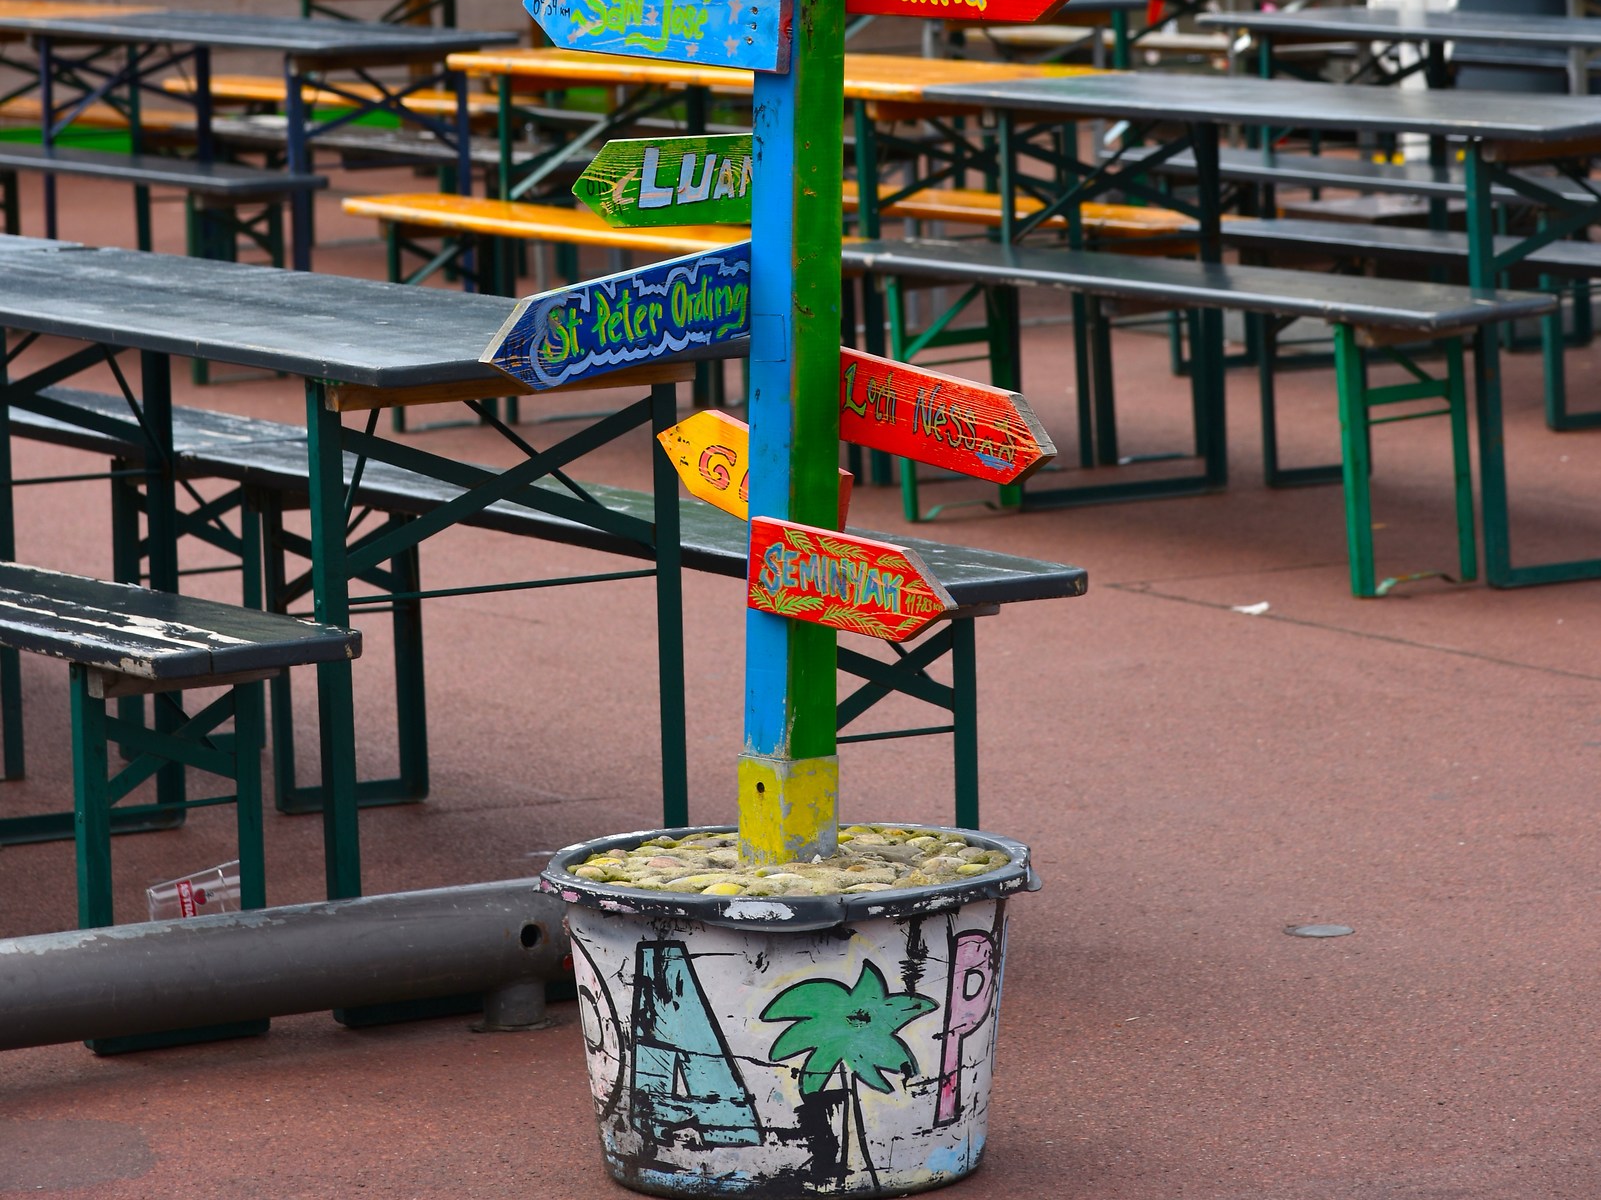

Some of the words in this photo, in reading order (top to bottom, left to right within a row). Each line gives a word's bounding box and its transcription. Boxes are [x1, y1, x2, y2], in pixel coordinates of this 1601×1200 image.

[591, 289, 663, 347] Peter
[671, 275, 749, 339] Ording
[843, 362, 897, 424] Loch
[913, 383, 976, 450] Ness
[759, 542, 904, 613] SEMINYAK
